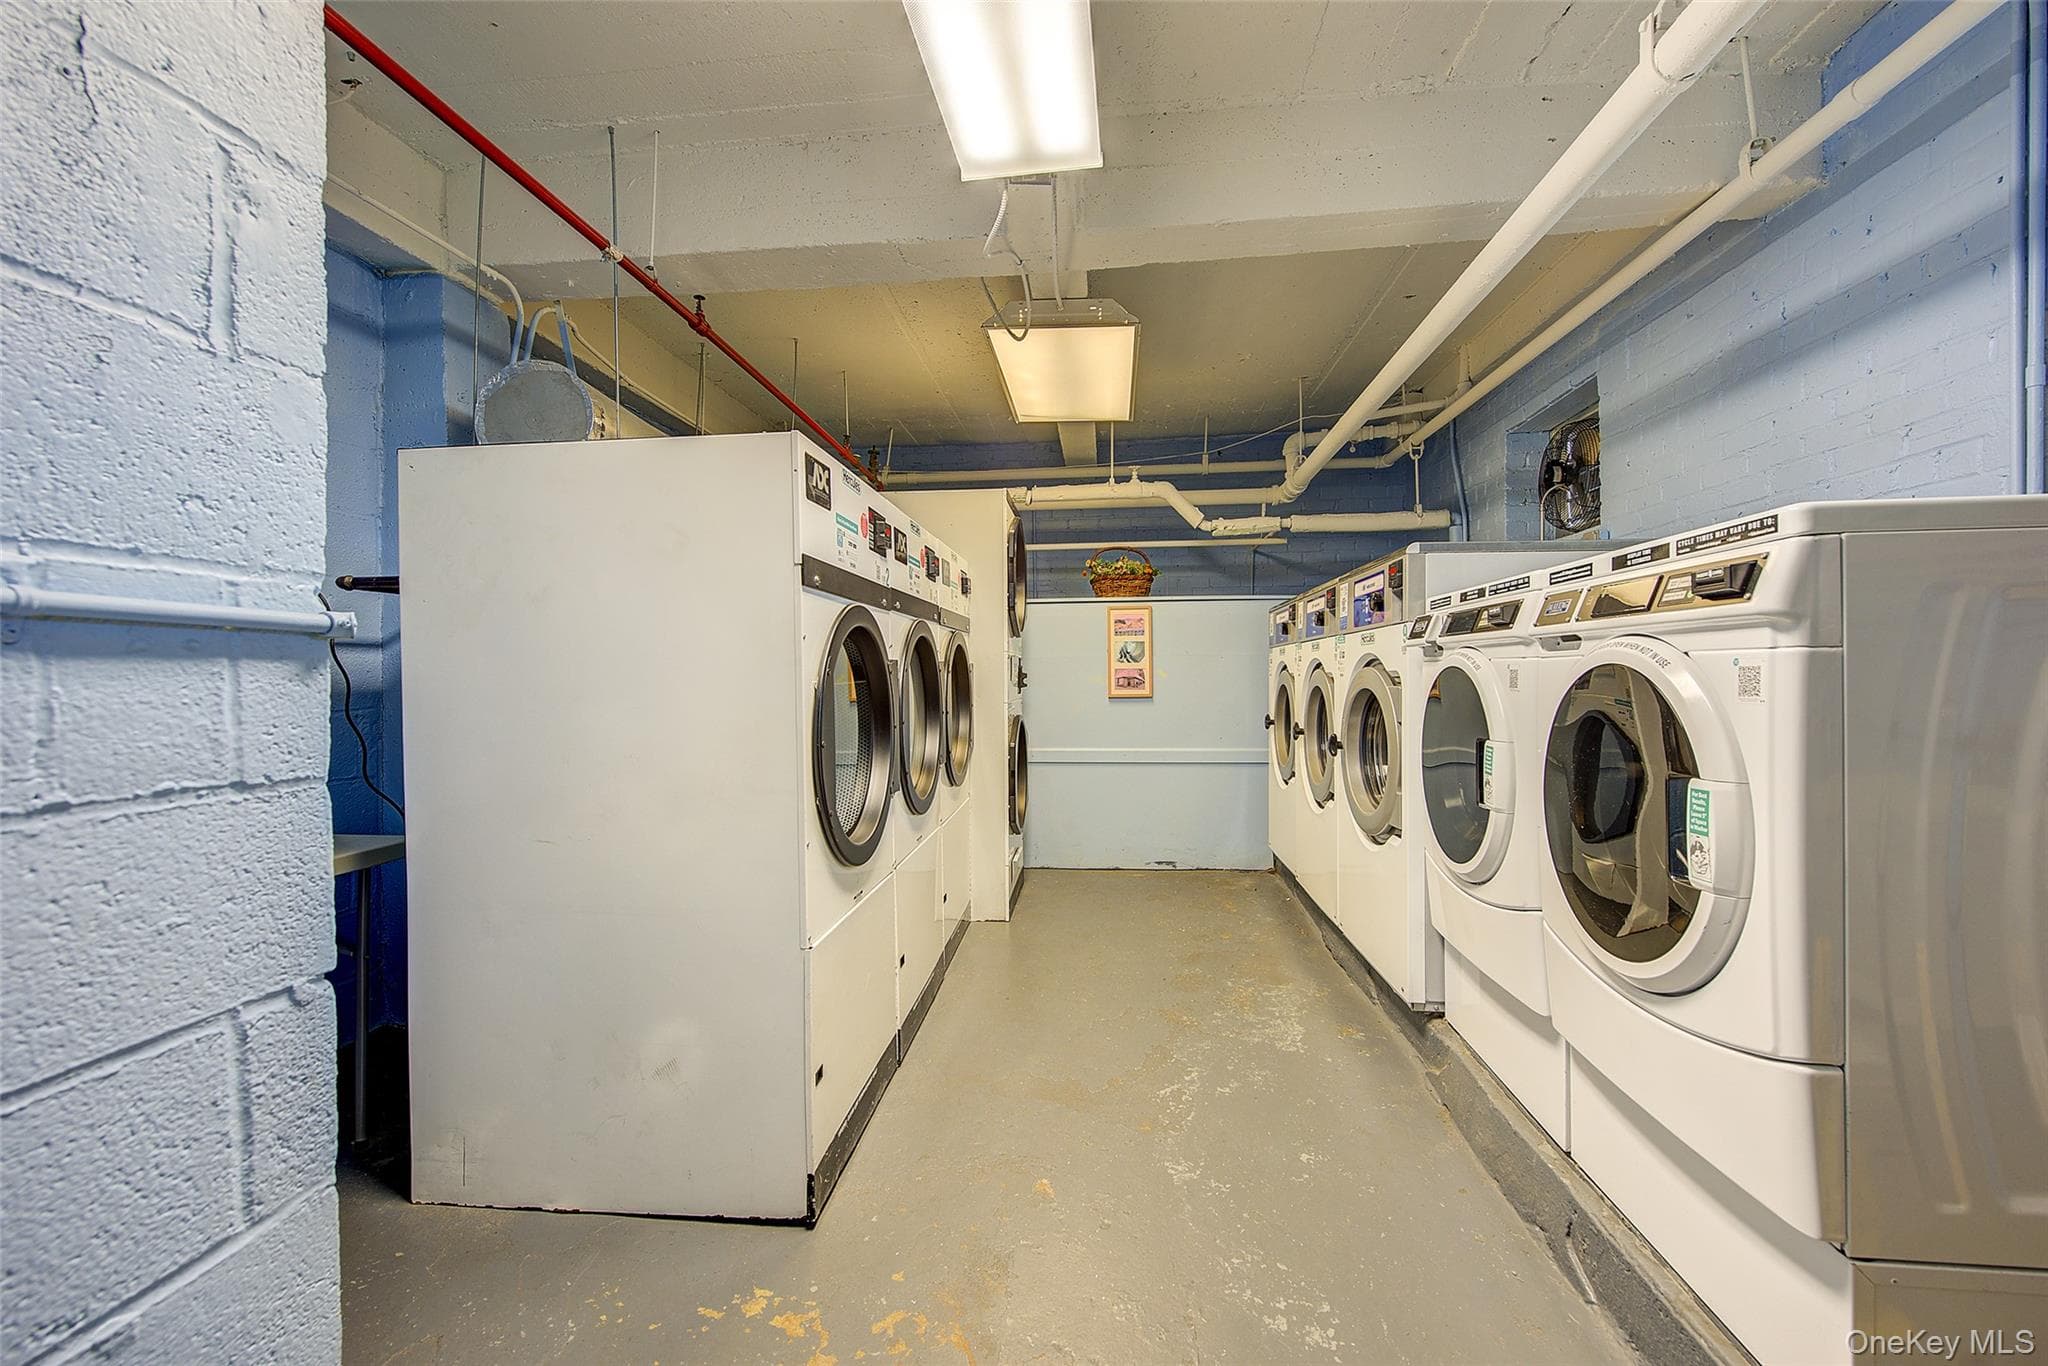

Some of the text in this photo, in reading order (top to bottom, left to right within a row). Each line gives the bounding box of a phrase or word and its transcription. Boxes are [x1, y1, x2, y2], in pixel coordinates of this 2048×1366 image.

[1677, 538, 1694, 548] CYCLE
[1696, 533, 1714, 543] TIMES
[1715, 528, 1728, 539] MAY
[1730, 524, 1746, 535] VARY
[1748, 520, 1761, 530] DUE
[1638, 646, 1654, 656] NOT
[1655, 656, 1672, 669] USE
